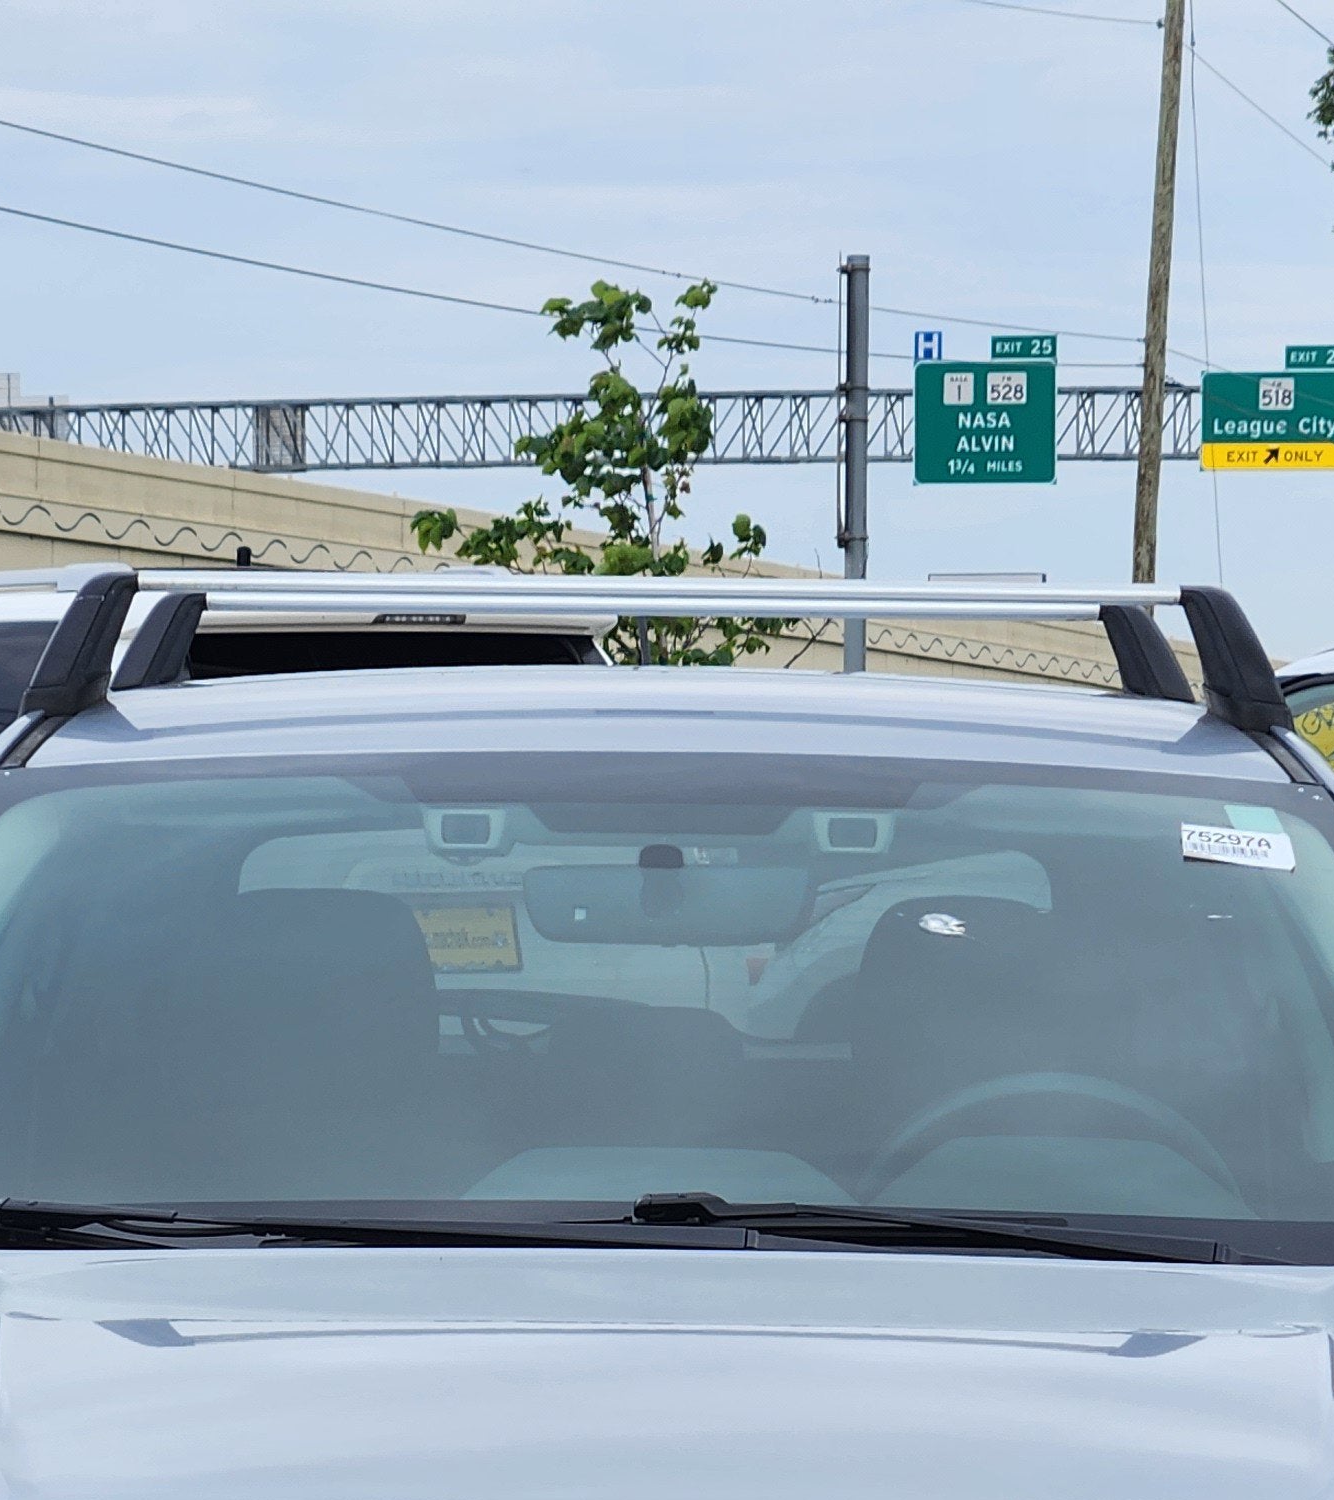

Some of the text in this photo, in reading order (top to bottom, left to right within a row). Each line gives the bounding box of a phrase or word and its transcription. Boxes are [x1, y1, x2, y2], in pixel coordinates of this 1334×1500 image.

[918, 332, 939, 359] H
[995, 339, 1053, 355] EXIT 25
[1289, 350, 1318, 363] EXIT
[990, 384, 1024, 401] 528
[1261, 389, 1292, 407] 518
[958, 411, 1011, 429] NASA
[1213, 417, 1287, 439] League
[956, 434, 1014, 453] ALVIN
[1226, 450, 1324, 463] EXIT ONLY
[986, 460, 1022, 473] MILES
[1182, 829, 1272, 850] 75297A
